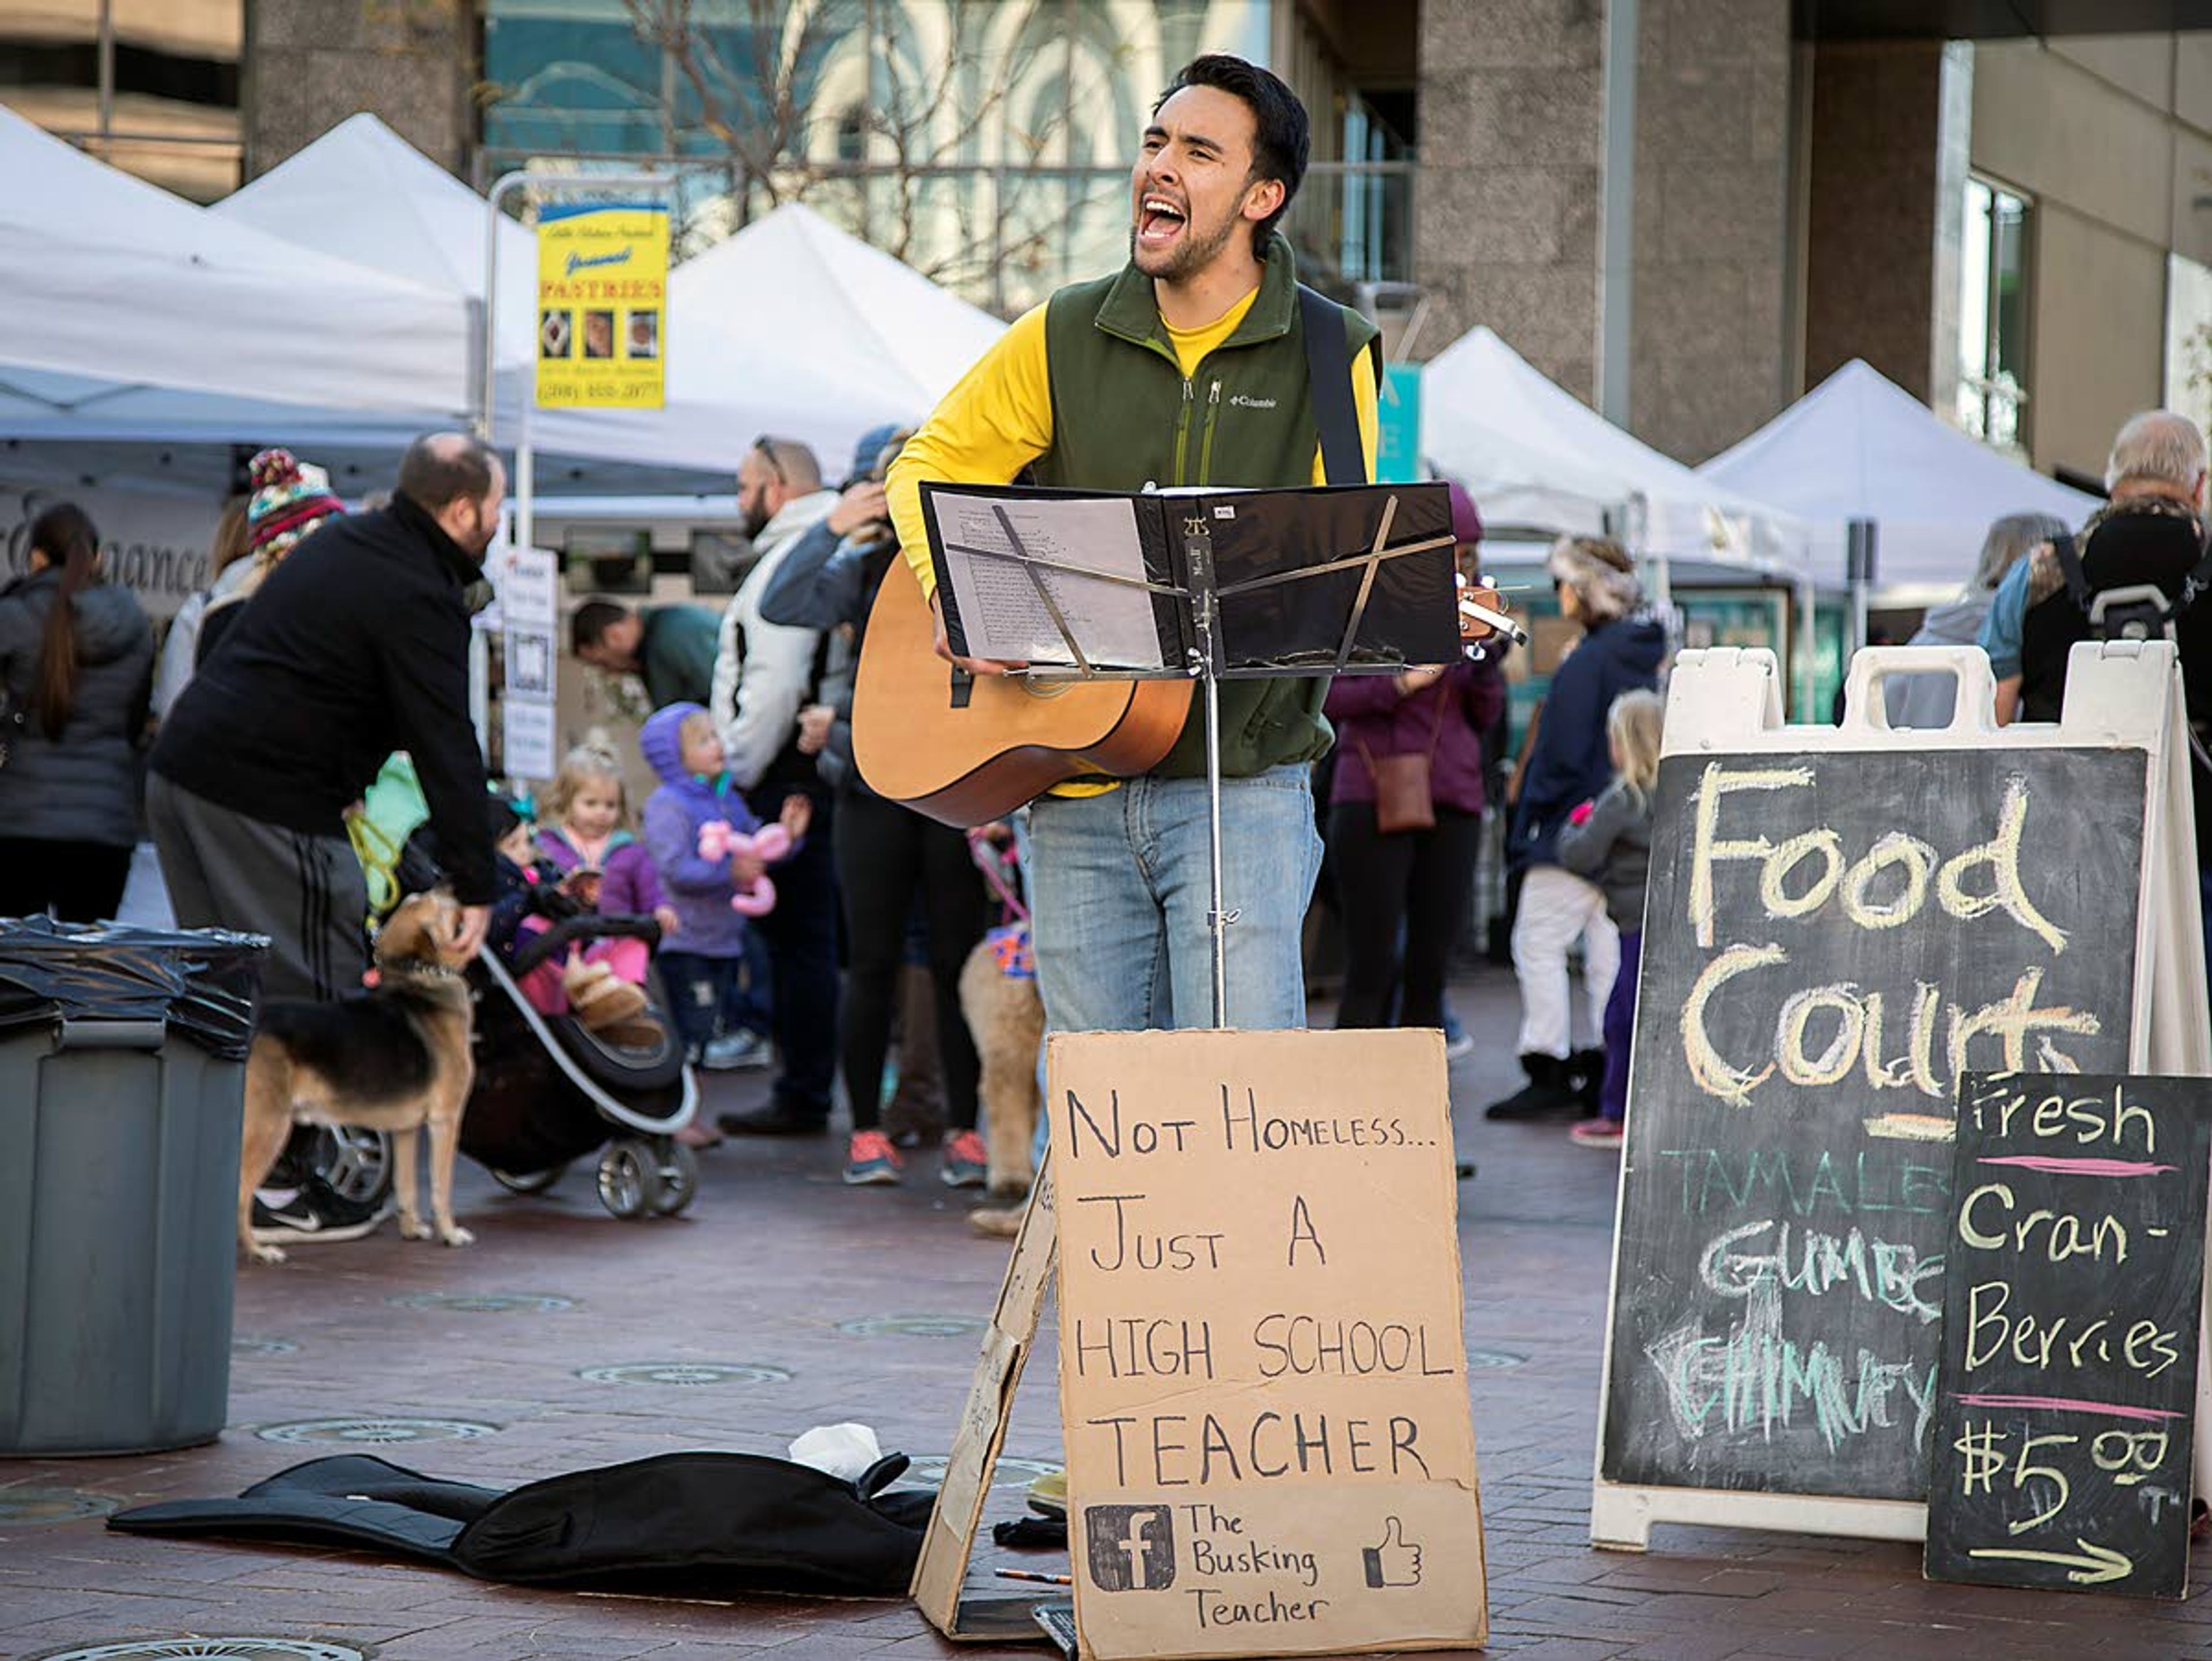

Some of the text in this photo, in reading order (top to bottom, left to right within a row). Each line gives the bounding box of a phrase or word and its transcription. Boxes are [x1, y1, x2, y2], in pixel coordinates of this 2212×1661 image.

[540, 280, 661, 298] PASTRIES
[1238, 395, 1277, 408] Columbia
[1688, 761, 2070, 956] Food
[1680, 941, 2101, 1107] Court
[1972, 1084, 2156, 1153] Fresh
[1288, 1194, 1327, 1267] A
[1075, 1314, 1455, 1380] HIGH SCHOOL
[1964, 1280, 2180, 1379] Berries
[1086, 1411, 1431, 1487] TEACHER
[1179, 1503, 1245, 1535] The
[1192, 1539, 1319, 1587] Busking
[1184, 1588, 1331, 1629] Teacher
